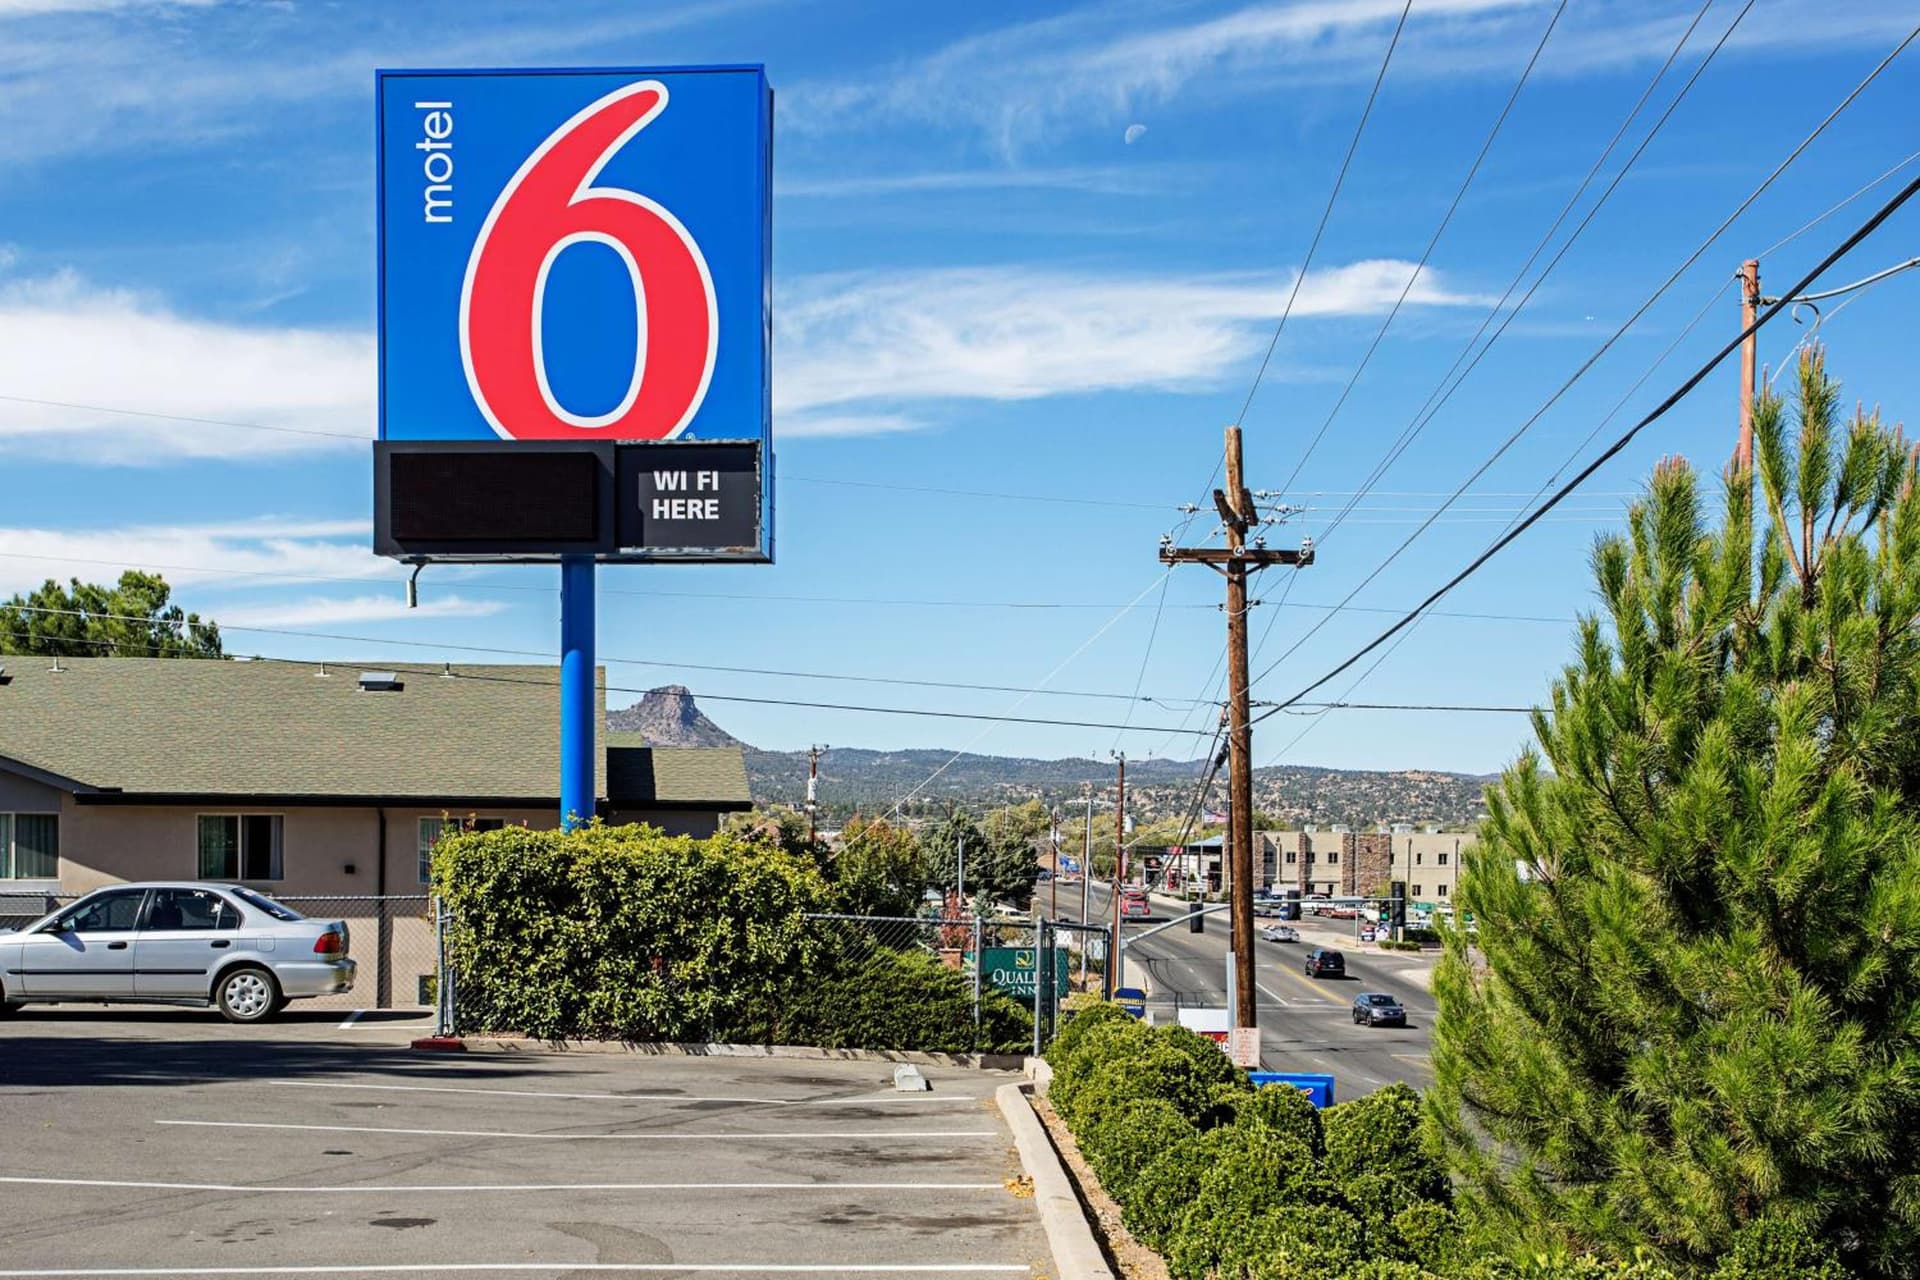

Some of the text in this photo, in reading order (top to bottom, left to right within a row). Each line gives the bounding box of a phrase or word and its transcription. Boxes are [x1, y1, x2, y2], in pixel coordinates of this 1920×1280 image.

[415, 101, 453, 223] motel
[458, 79, 719, 440] 6
[653, 470, 719, 491] WI FI
[652, 498, 720, 520] HERE
[992, 968, 1050, 986] QUALI
